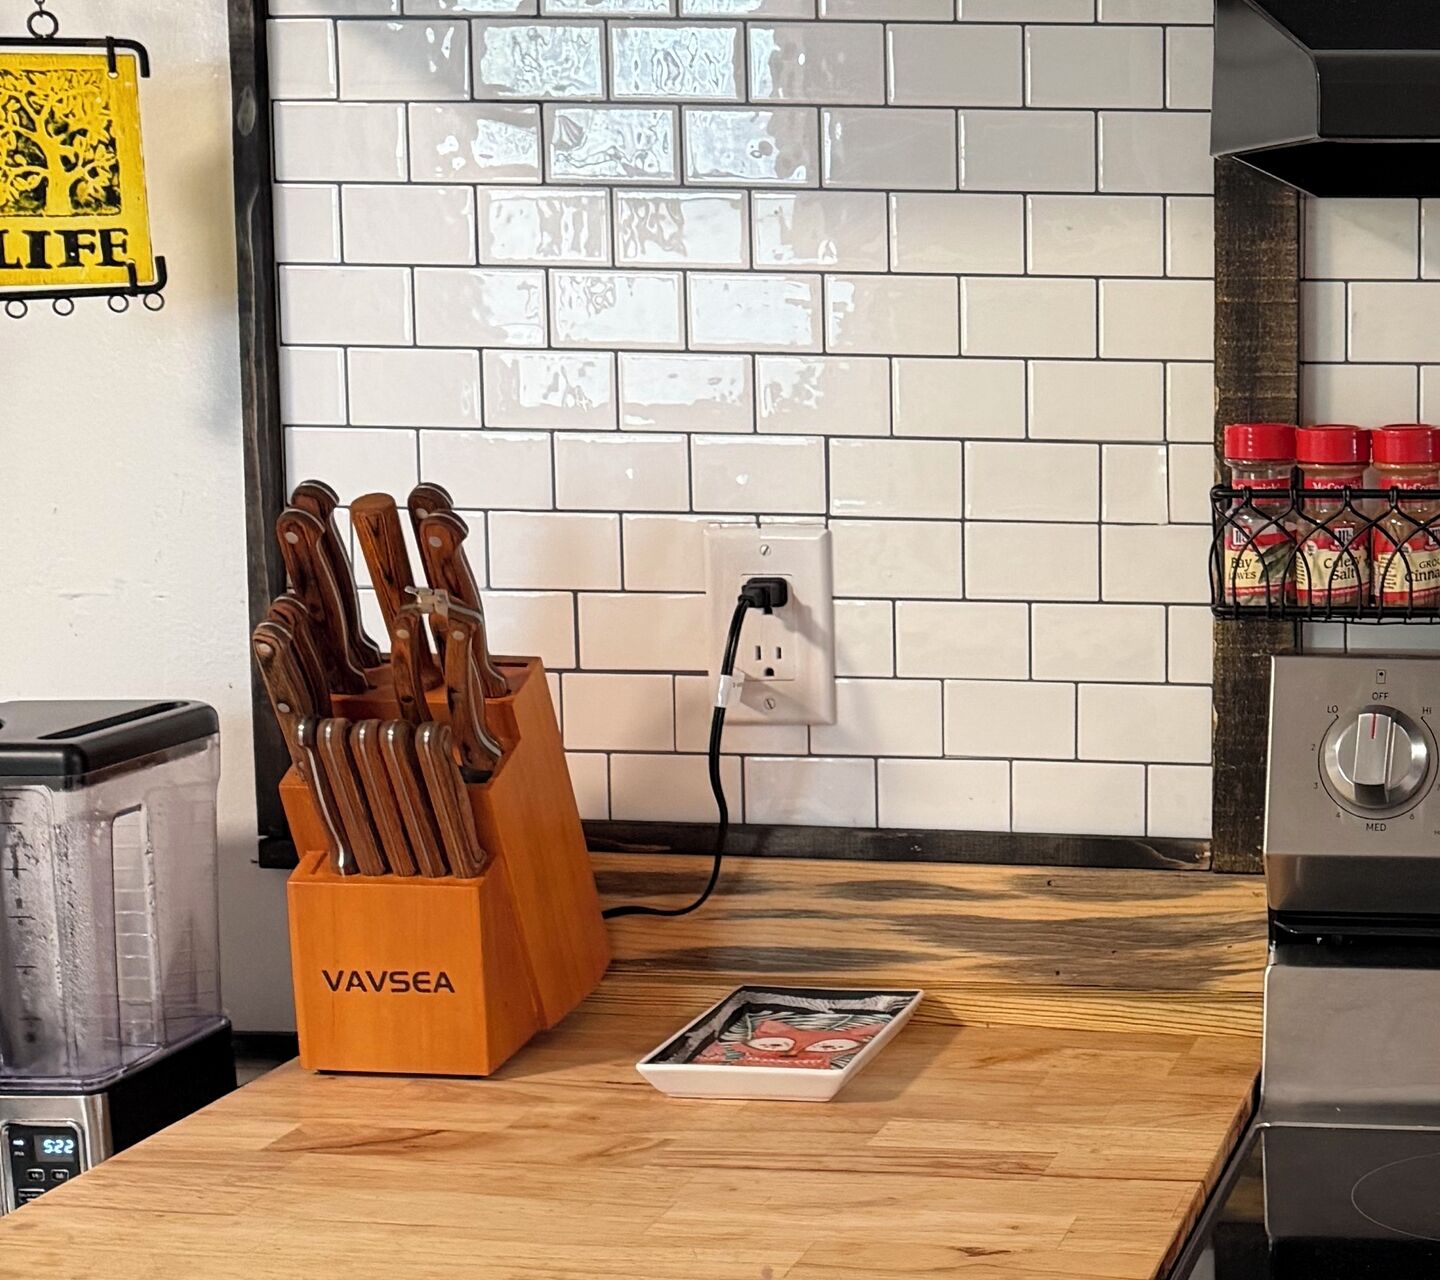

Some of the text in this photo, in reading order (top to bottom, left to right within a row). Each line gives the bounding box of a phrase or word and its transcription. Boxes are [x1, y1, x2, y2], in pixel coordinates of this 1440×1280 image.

[1371, 692, 1389, 701] OFF
[1327, 705, 1339, 714] LO
[1422, 707, 1432, 715] HI
[1365, 823, 1387, 832] MED
[321, 969, 456, 994] VAVSEA
